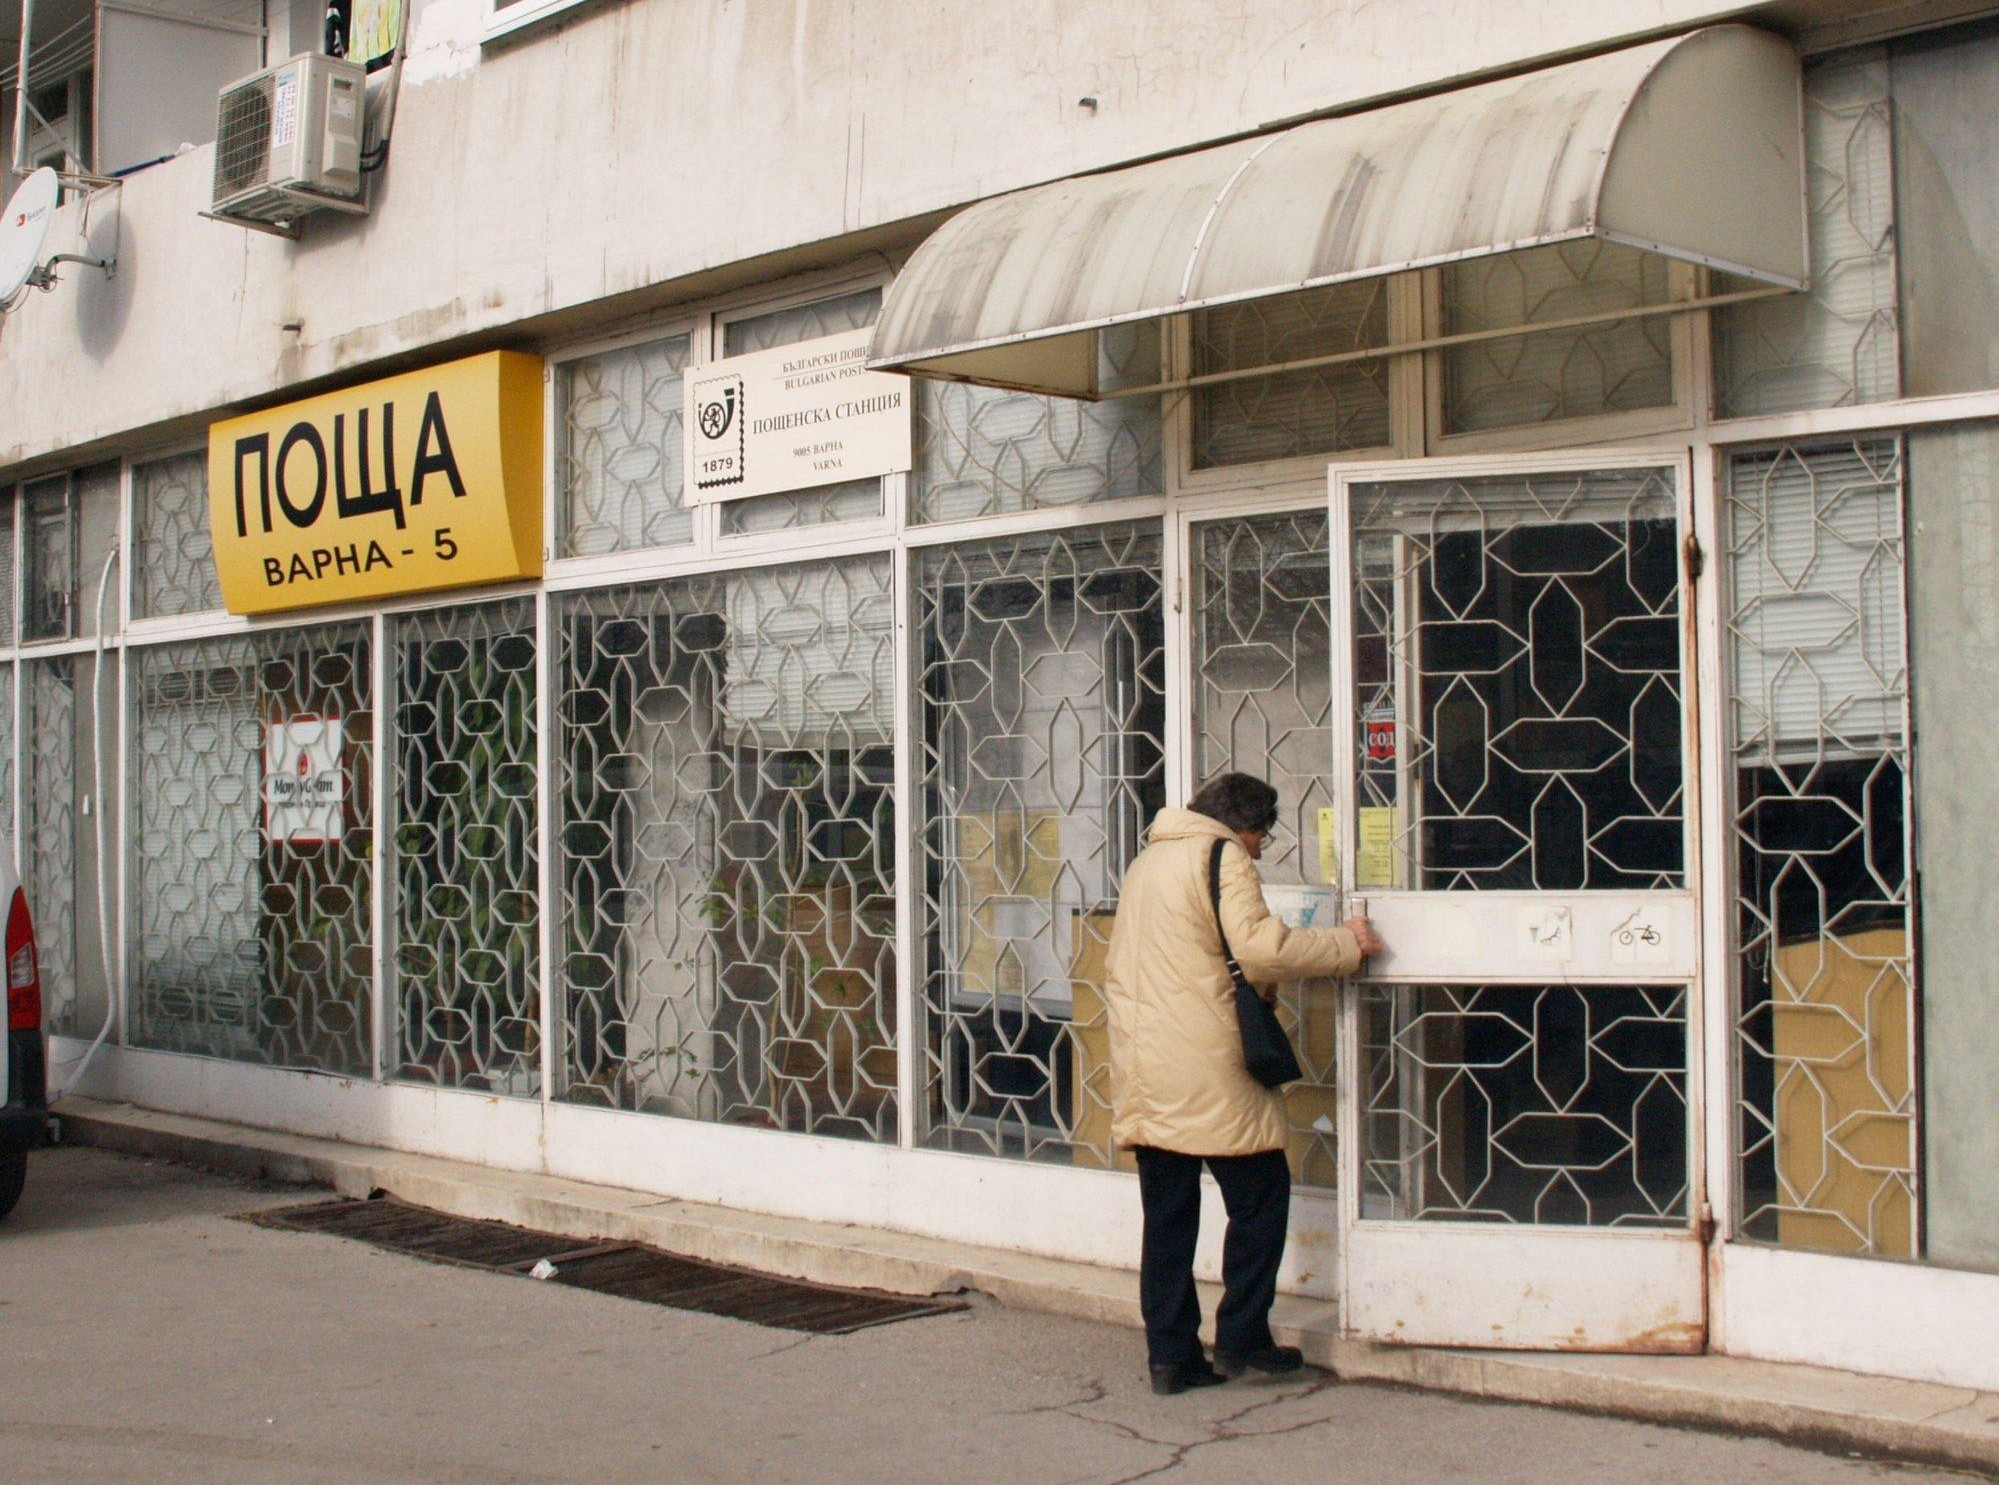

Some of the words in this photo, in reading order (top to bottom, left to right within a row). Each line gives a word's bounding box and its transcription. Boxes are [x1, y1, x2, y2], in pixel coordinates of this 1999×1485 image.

[782, 353, 838, 373] БЪЛГАРСКИ
[785, 370, 838, 390] BULGARIAN
[753, 408, 832, 434] ПОЩЕНСКА
[835, 392, 902, 419] СТАНЦИЯ
[813, 441, 843, 455] ВАРНА
[234, 391, 467, 537] ПОЩА
[702, 457, 733, 473] 1879
[813, 459, 843, 471] VARNA
[263, 540, 393, 587] ВАРНА
[434, 528, 458, 561] 5
